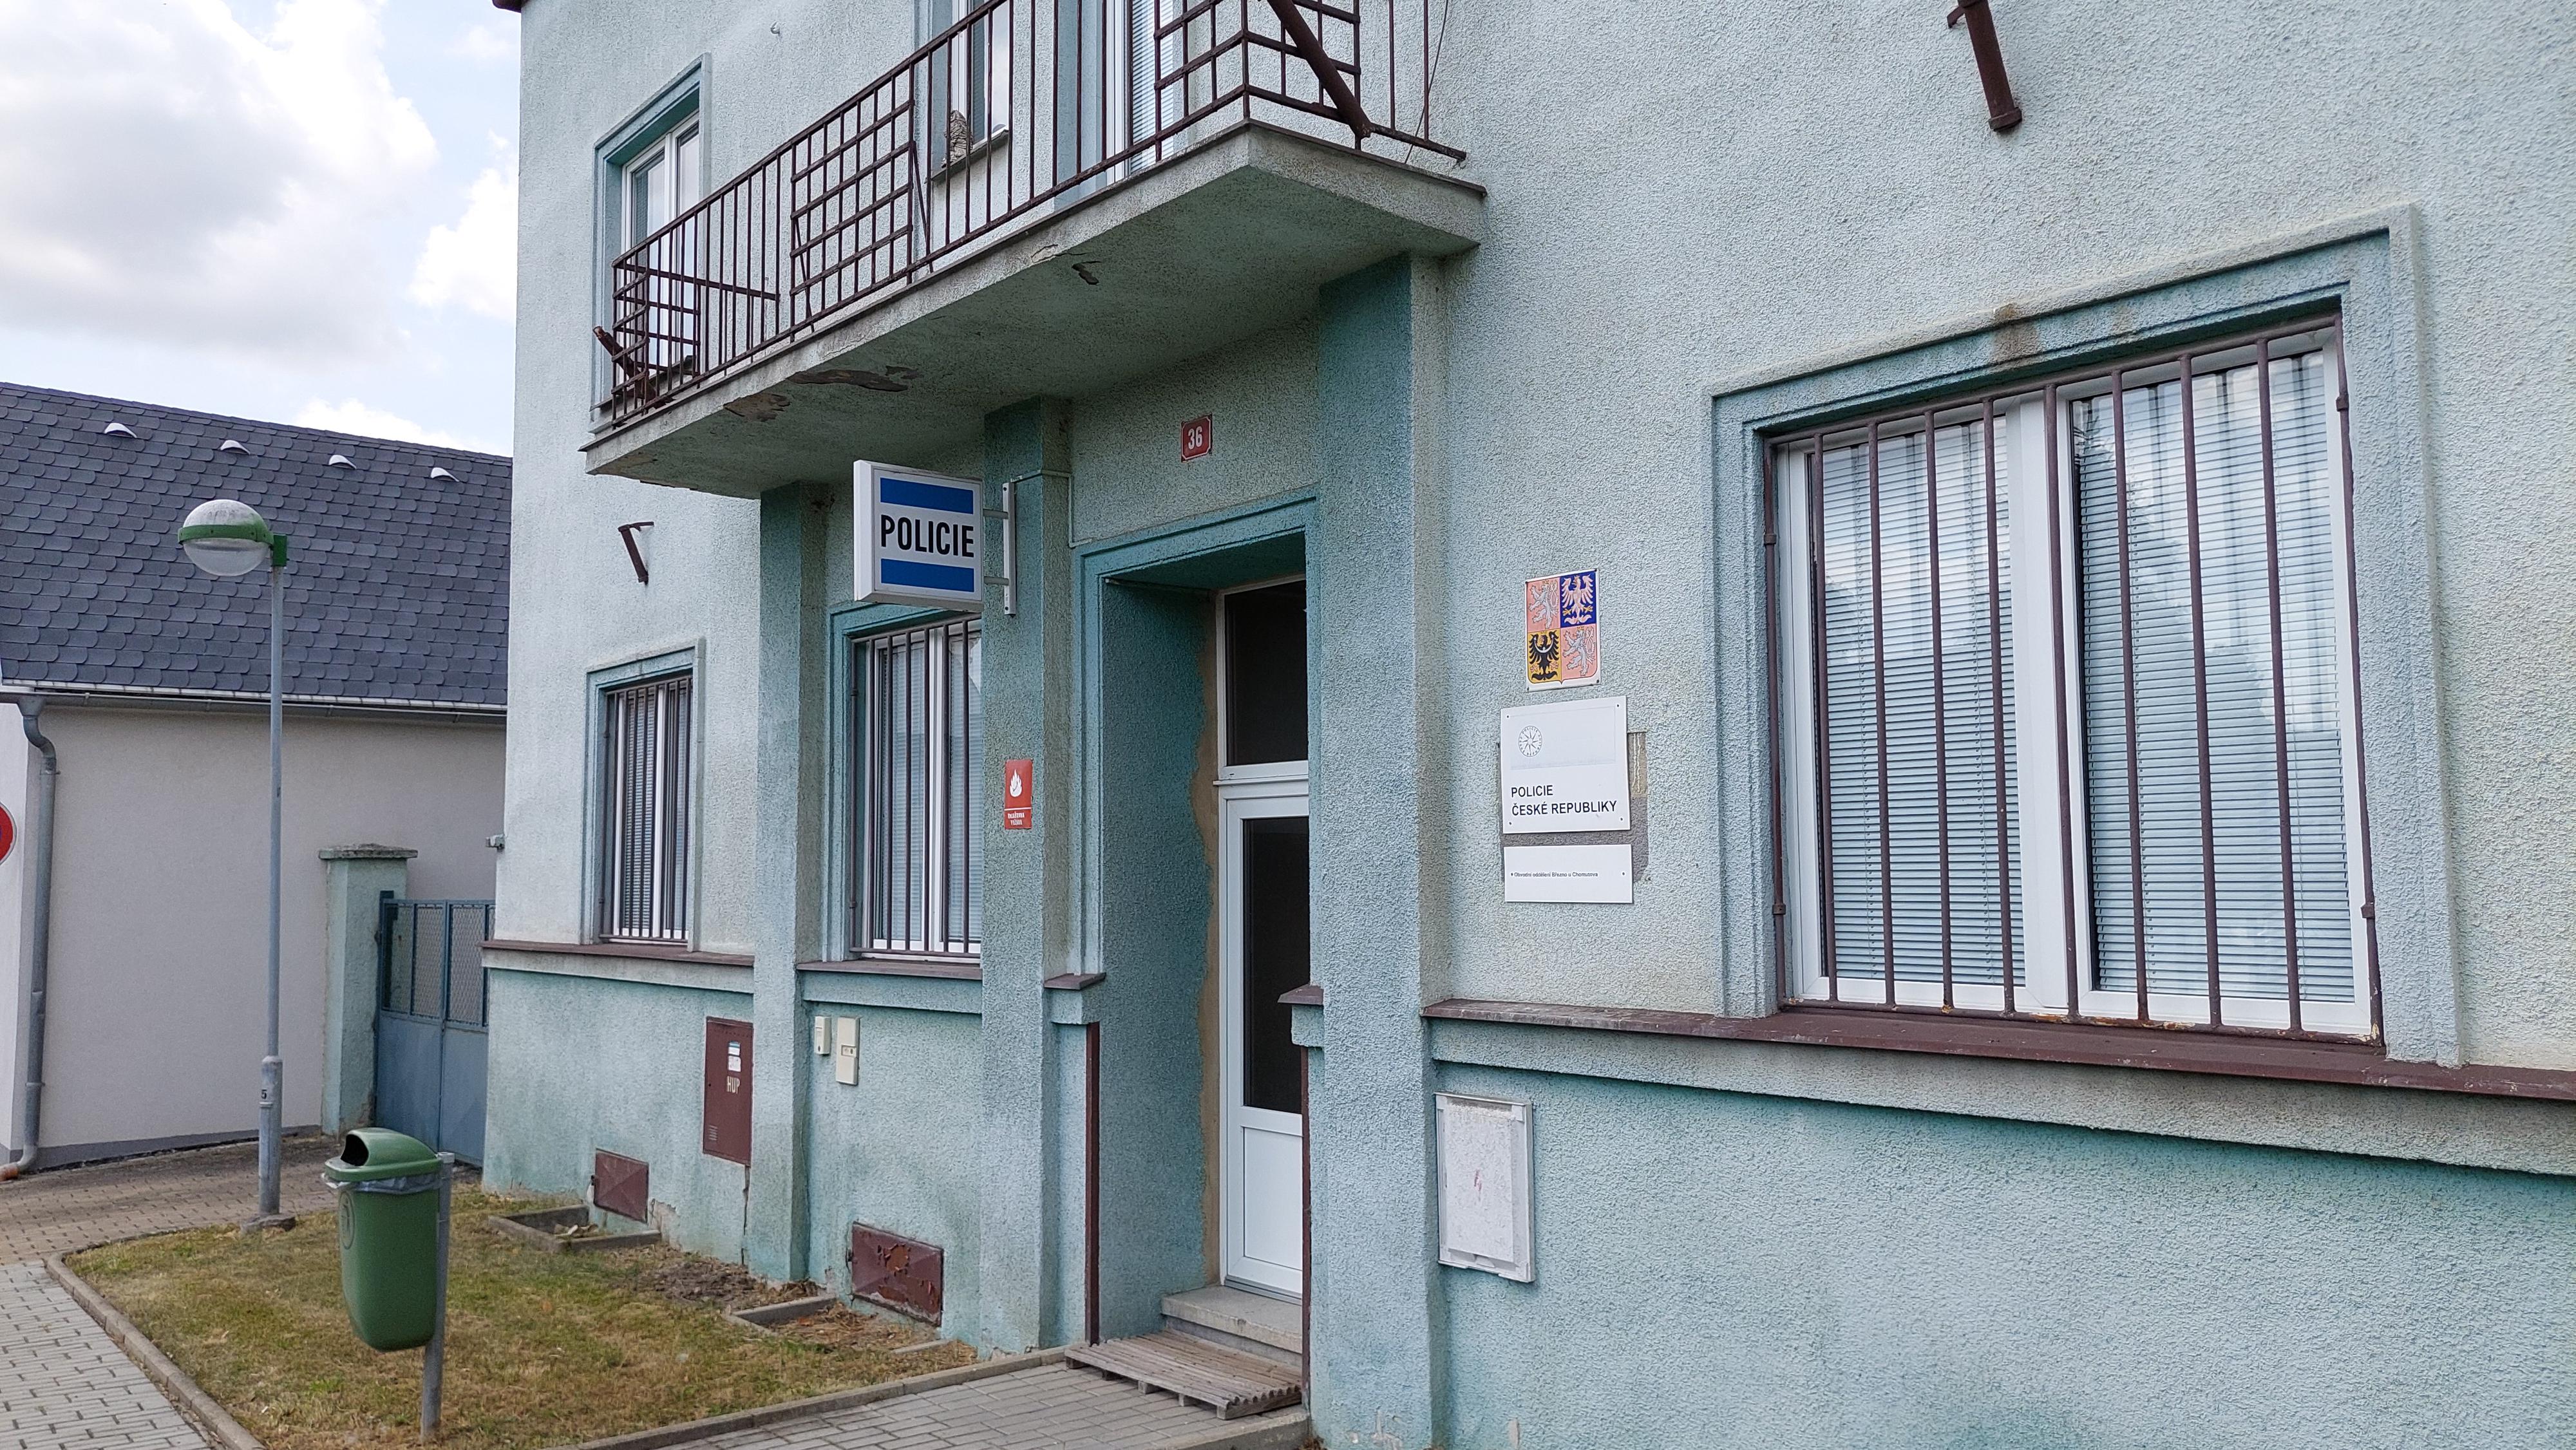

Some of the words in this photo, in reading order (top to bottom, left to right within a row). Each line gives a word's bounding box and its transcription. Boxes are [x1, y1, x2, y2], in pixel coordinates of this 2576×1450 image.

[1188, 426, 1202, 449] 36
[881, 514, 974, 558] POLICIE
[1511, 785, 1553, 798] POLICIE
[1512, 802, 1548, 816] ČESKÉ
[1551, 800, 1617, 814] REPUBLIKY
[727, 1076, 740, 1094] HUP
[261, 1089, 267, 1099] 5
